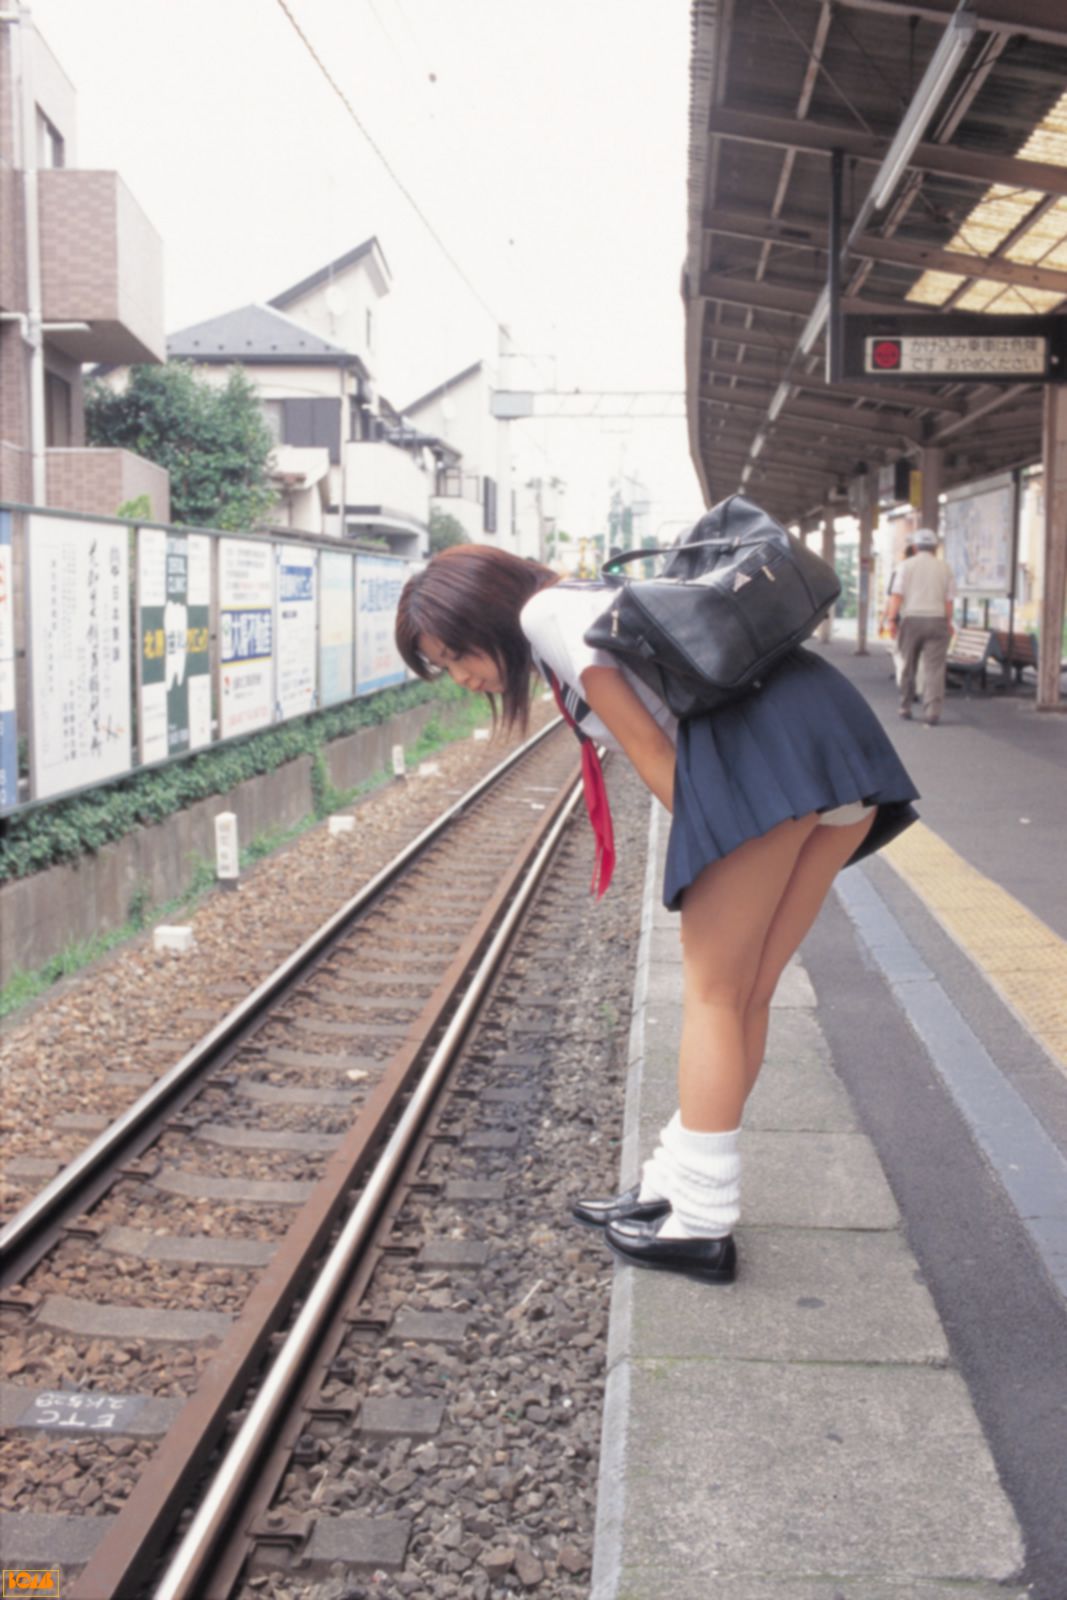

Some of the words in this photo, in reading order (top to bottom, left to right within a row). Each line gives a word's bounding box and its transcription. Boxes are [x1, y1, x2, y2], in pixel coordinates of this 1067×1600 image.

[911, 357, 935, 370] です
[946, 357, 1039, 370] おやめください
[36, 1412, 116, 1428] ETC
